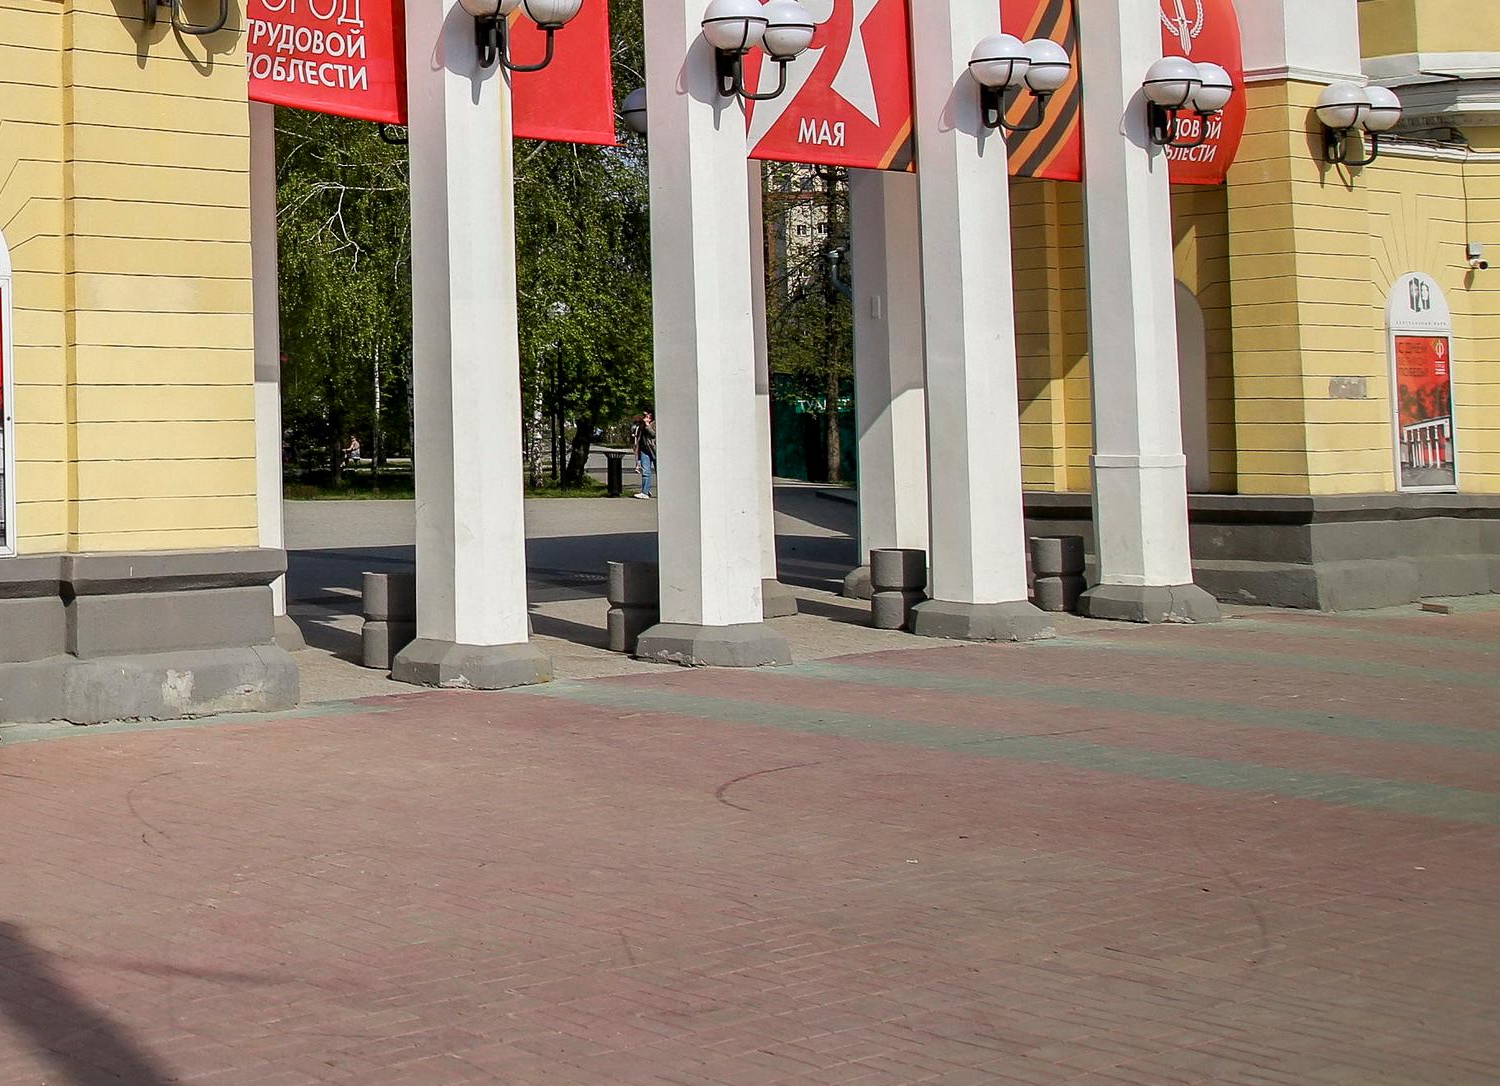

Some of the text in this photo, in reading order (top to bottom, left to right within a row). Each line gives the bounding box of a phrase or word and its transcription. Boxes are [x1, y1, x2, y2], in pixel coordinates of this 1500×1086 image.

[246, 18, 366, 59] ТРУДОВОЙ
[798, 117, 845, 147] МАЯ
[1165, 143, 1218, 163] БЛЕСТИ
